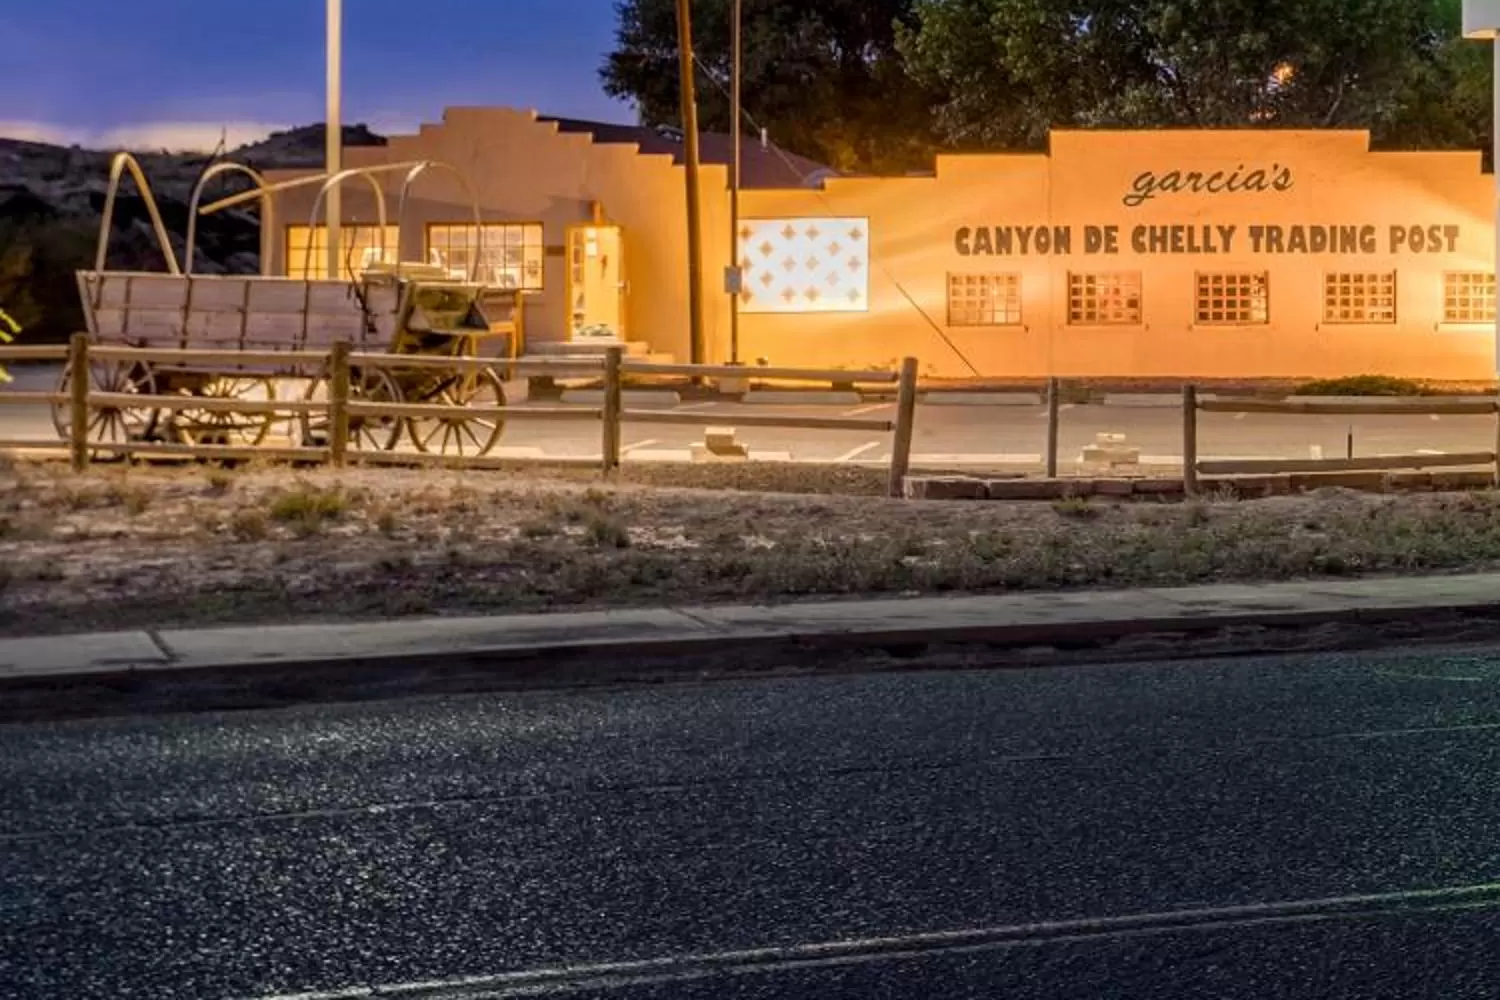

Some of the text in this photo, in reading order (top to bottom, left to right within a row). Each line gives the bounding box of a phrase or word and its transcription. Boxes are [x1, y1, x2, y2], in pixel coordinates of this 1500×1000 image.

[1122, 163, 1294, 206] garcia's
[954, 224, 1460, 255] CANYON DE CHELLY TRADING POST
